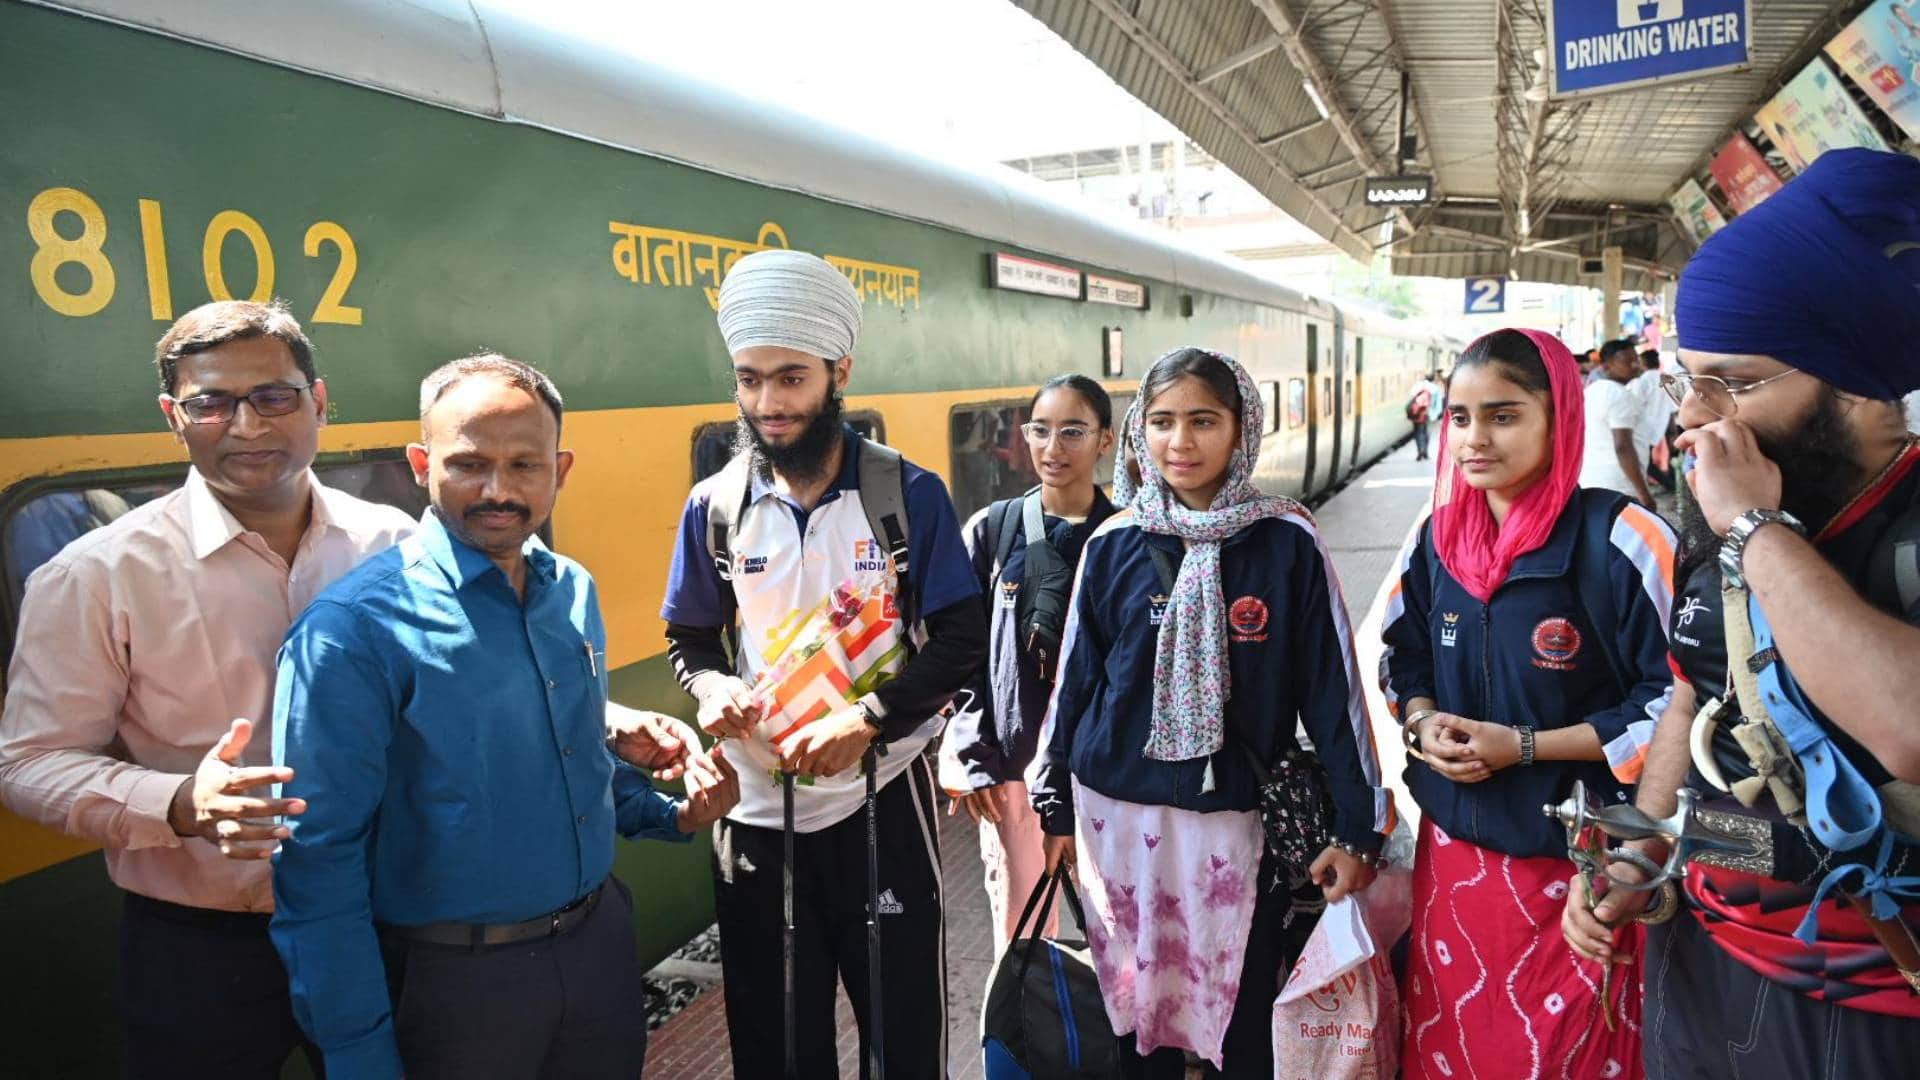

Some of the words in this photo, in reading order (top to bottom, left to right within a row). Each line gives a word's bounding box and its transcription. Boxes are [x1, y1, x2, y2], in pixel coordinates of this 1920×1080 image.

[1565, 26, 1662, 71] DRINKING
[1667, 13, 1739, 53] WATER
[27, 187, 363, 325] 8102
[1470, 279, 1500, 311] 2
[1300, 1022, 1342, 1040] Ready
